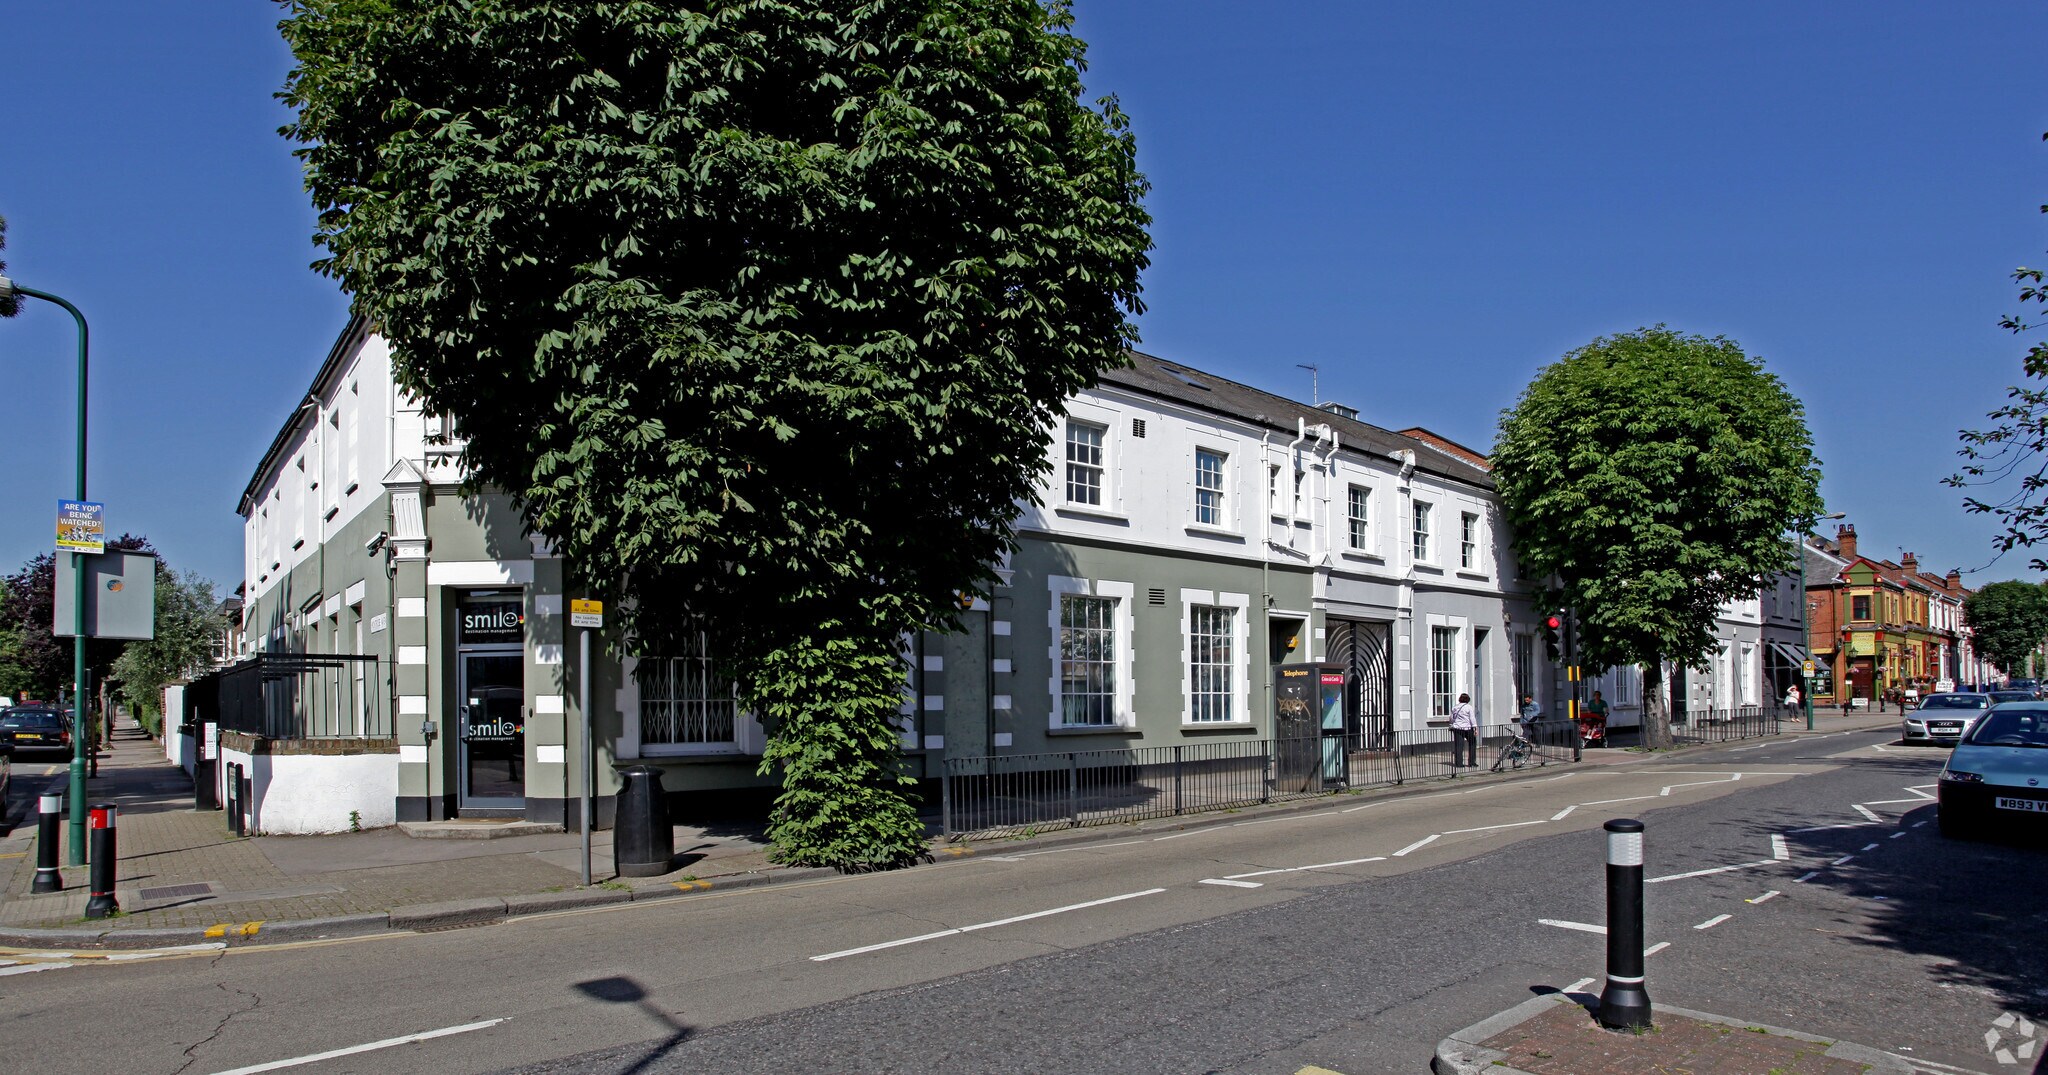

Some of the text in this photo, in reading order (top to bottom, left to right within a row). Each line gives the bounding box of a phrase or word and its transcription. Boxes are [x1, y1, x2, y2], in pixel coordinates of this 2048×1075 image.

[69, 511, 93, 519] BEING
[60, 518, 101, 527] WATCHED?
[2000, 799, 2033, 809] W893
